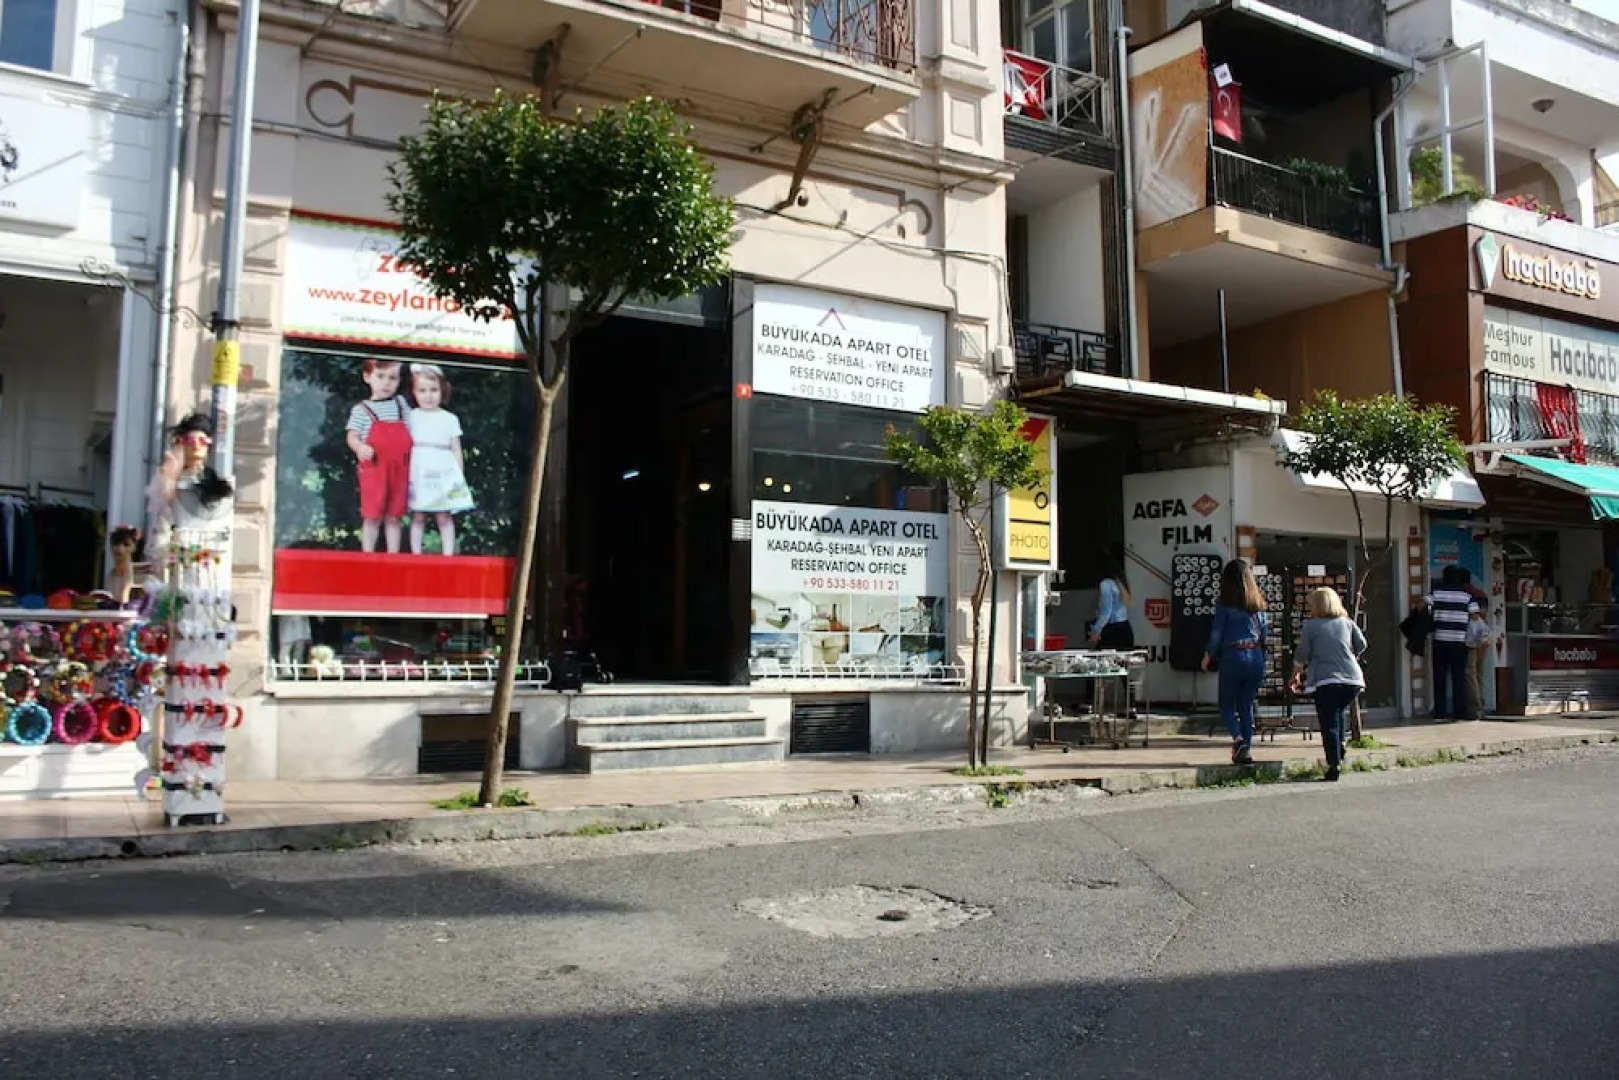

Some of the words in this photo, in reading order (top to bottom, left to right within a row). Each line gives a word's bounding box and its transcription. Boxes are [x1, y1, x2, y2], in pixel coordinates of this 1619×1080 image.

[761, 321, 842, 349] BÜYÜKADA
[847, 338, 891, 356] APART
[896, 345, 930, 362] OTEL
[902, 365, 933, 379] APART
[817, 386, 839, 399] 533
[851, 391, 871, 403] 580
[877, 395, 888, 406] 11
[1132, 498, 1188, 520] AGFA
[756, 507, 844, 534] BÜYÜKADA
[849, 518, 897, 537] APART
[902, 522, 940, 539] OTEL
[1010, 533, 1048, 550] PHOTO
[1161, 523, 1212, 545] FILM
[896, 545, 929, 558] APART
[873, 579, 883, 590] 11
[887, 580, 899, 591] 21
